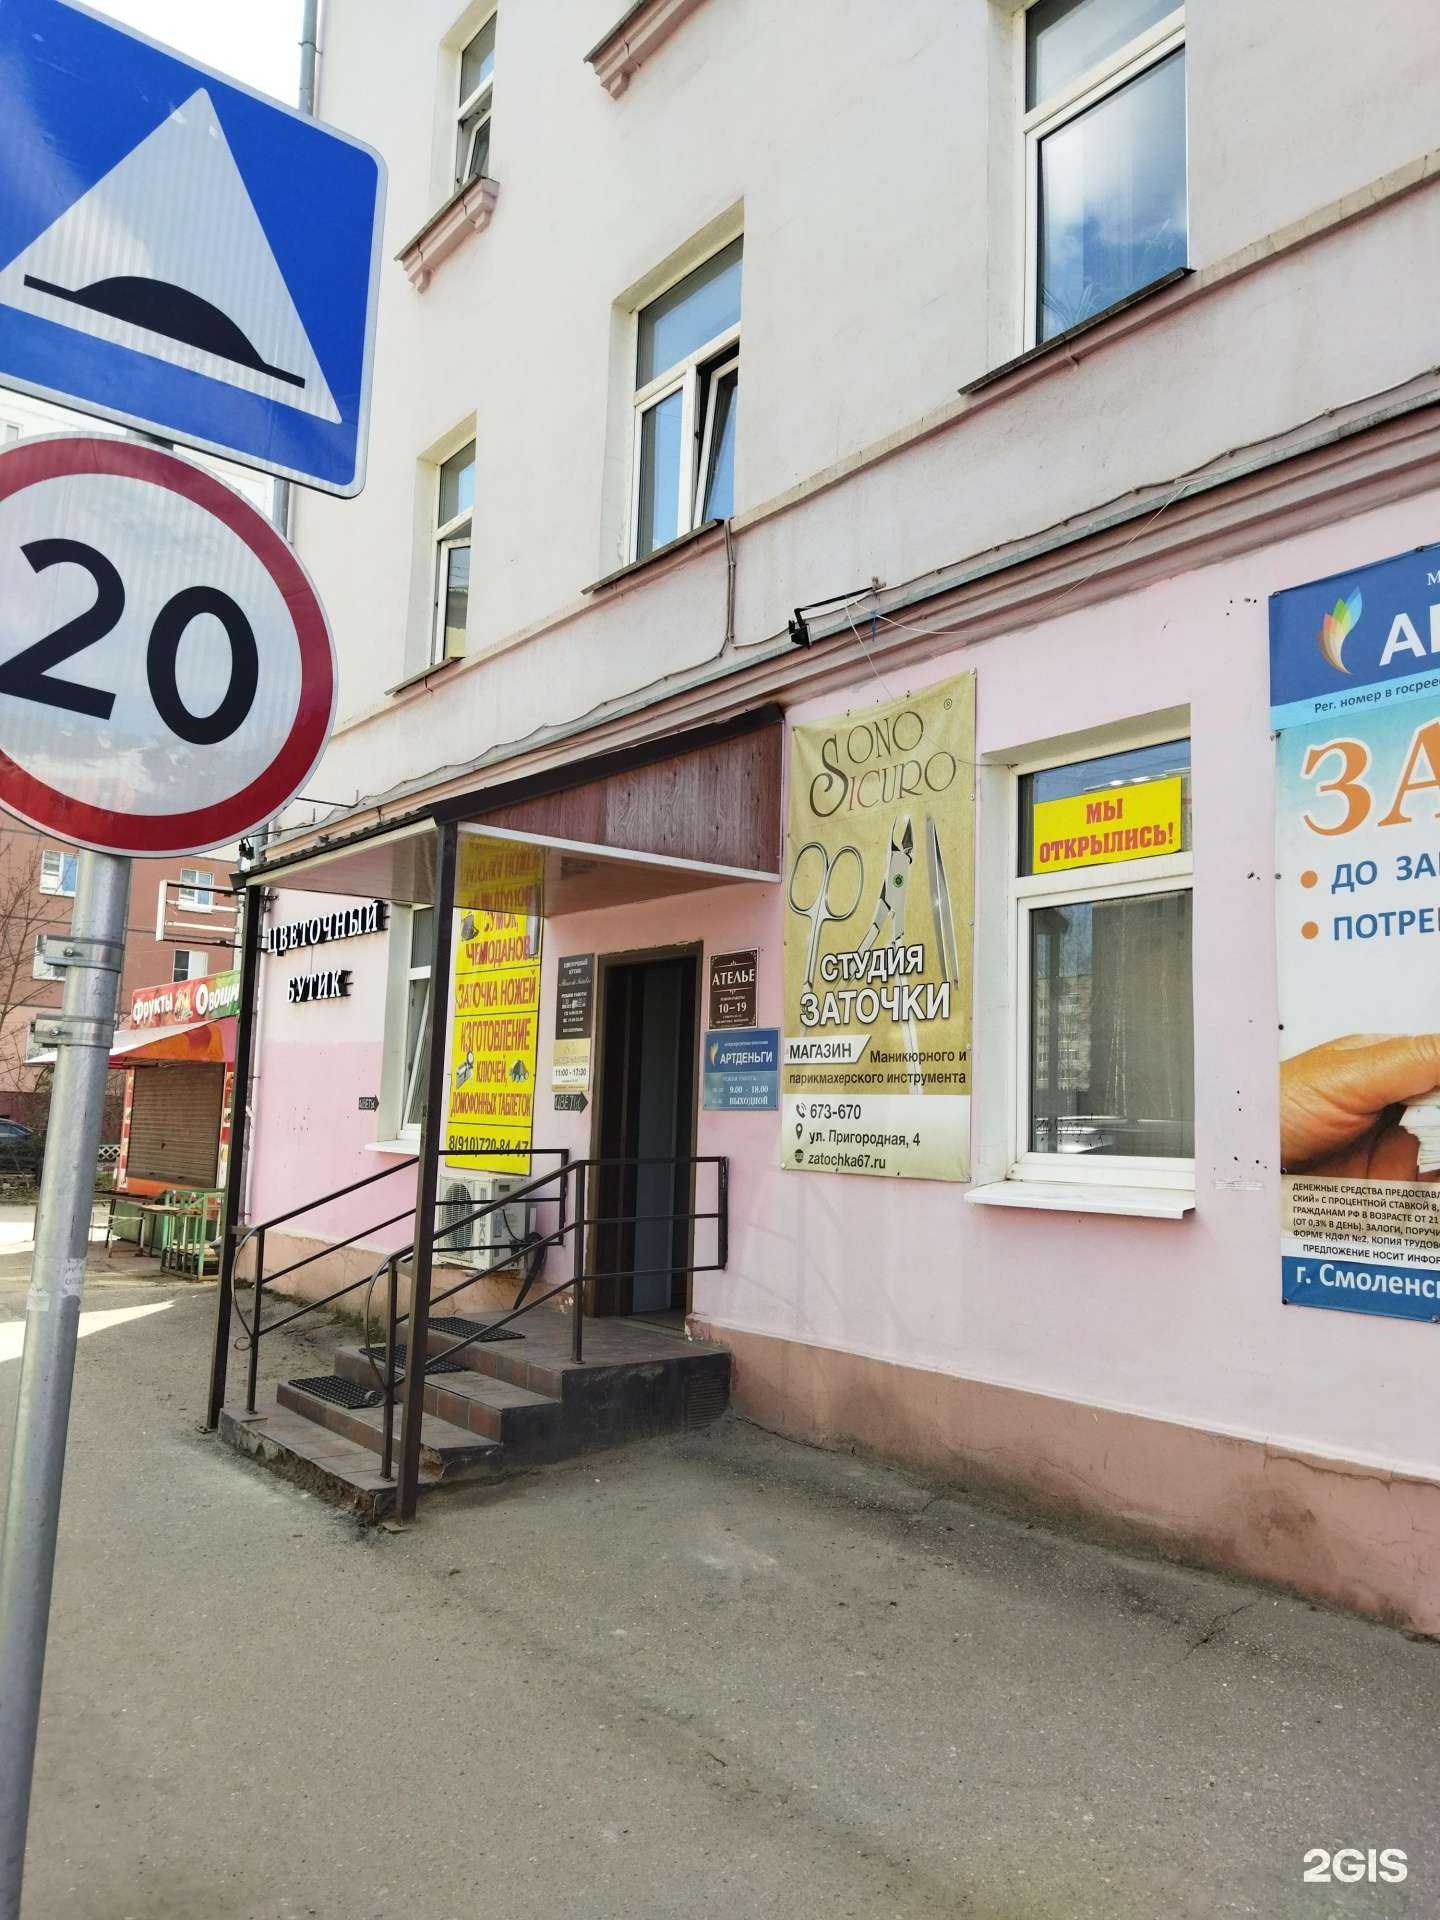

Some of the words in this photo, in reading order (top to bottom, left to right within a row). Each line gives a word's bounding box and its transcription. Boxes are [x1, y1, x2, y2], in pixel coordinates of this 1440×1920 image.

[0, 538, 259, 745] 20
[1314, 702, 1337, 714] Рег.
[1341, 690, 1382, 709] номер
[1385, 688, 1392, 698] в
[1395, 677, 1440, 695] госрее
[1086, 798, 1123, 825] МЫ
[1039, 822, 1174, 863] ОТКРЫЛИСЬ!
[1331, 860, 1378, 894] ДО
[1396, 852, 1440, 881] ЗА
[268, 900, 380, 954] ЦВЕТОЧНЫЙ
[1334, 906, 1440, 941] ПОТРЕ
[712, 968, 755, 986] АТЕЛЬЕ
[820, 944, 924, 984] СТУДИЯ
[287, 970, 342, 1003] БУТИК
[458, 981, 498, 1009] ЗАТОЧКА
[500, 969, 537, 1006] НОЖЕЙ
[132, 993, 174, 1024] Фрукты
[800, 981, 951, 1027] ЗАТОЧКИ
[460, 1018, 531, 1053] ИЗГОТОВЛЕНИЕ
[719, 1051, 773, 1066] АРТДЕНЬГИ
[789, 1042, 852, 1060] МАГАЗИН
[870, 1048, 955, 1065] Маникюрного
[958, 1050, 967, 1062] и
[789, 1073, 884, 1086] парикмахерского
[887, 1071, 966, 1086] инструмента
[450, 1091, 497, 1117] ДОМОФОННЫХ
[498, 1092, 532, 1117] ТАБЛЕТОК
[810, 1104, 861, 1120] 673-670
[809, 1131, 825, 1144] ул.
[828, 1130, 909, 1147] Пригородная,
[912, 1133, 921, 1146] 4
[808, 1152, 886, 1169] zatochka67.ru
[1292, 1182, 1339, 1193] ДЕНЕЖНЫЕ
[1340, 1185, 1383, 1196] СРЕДСТВА
[1292, 1206, 1346, 1217] ГРАЖДАНАМ
[1347, 1210, 1360, 1218] РФ
[1362, 1211, 1368, 1219] В
[1369, 1211, 1412, 1222] ВОЗРАСТЕ
[1414, 1215, 1426, 1223] ОТ
[1321, 1196, 1327, 1204] С
[1328, 1196, 1387, 1208] ПРОЦЕНТНОЙ
[1388, 1200, 1429, 1211] СТАВКОЙ
[1293, 1218, 1307, 1227] (ОТ
[1328, 1220, 1334, 1228] В
[1366, 1223, 1403, 1235] ЗАЛОГИ,
[1293, 1229, 1324, 1239] ФОРМЕ
[1325, 1233, 1350, 1242] НДФЛ
[1371, 1236, 1402, 1246] КОПИЯ
[1404, 1238, 1440, 1250] ТРУДОВ
[1303, 1244, 1370, 1258] ПРЕДЛОЖЕНИЕ
[1372, 1251, 1404, 1261] НОСИТ
[1296, 1266, 1312, 1285] г.
[1319, 1263, 1440, 1299] Смоленс
